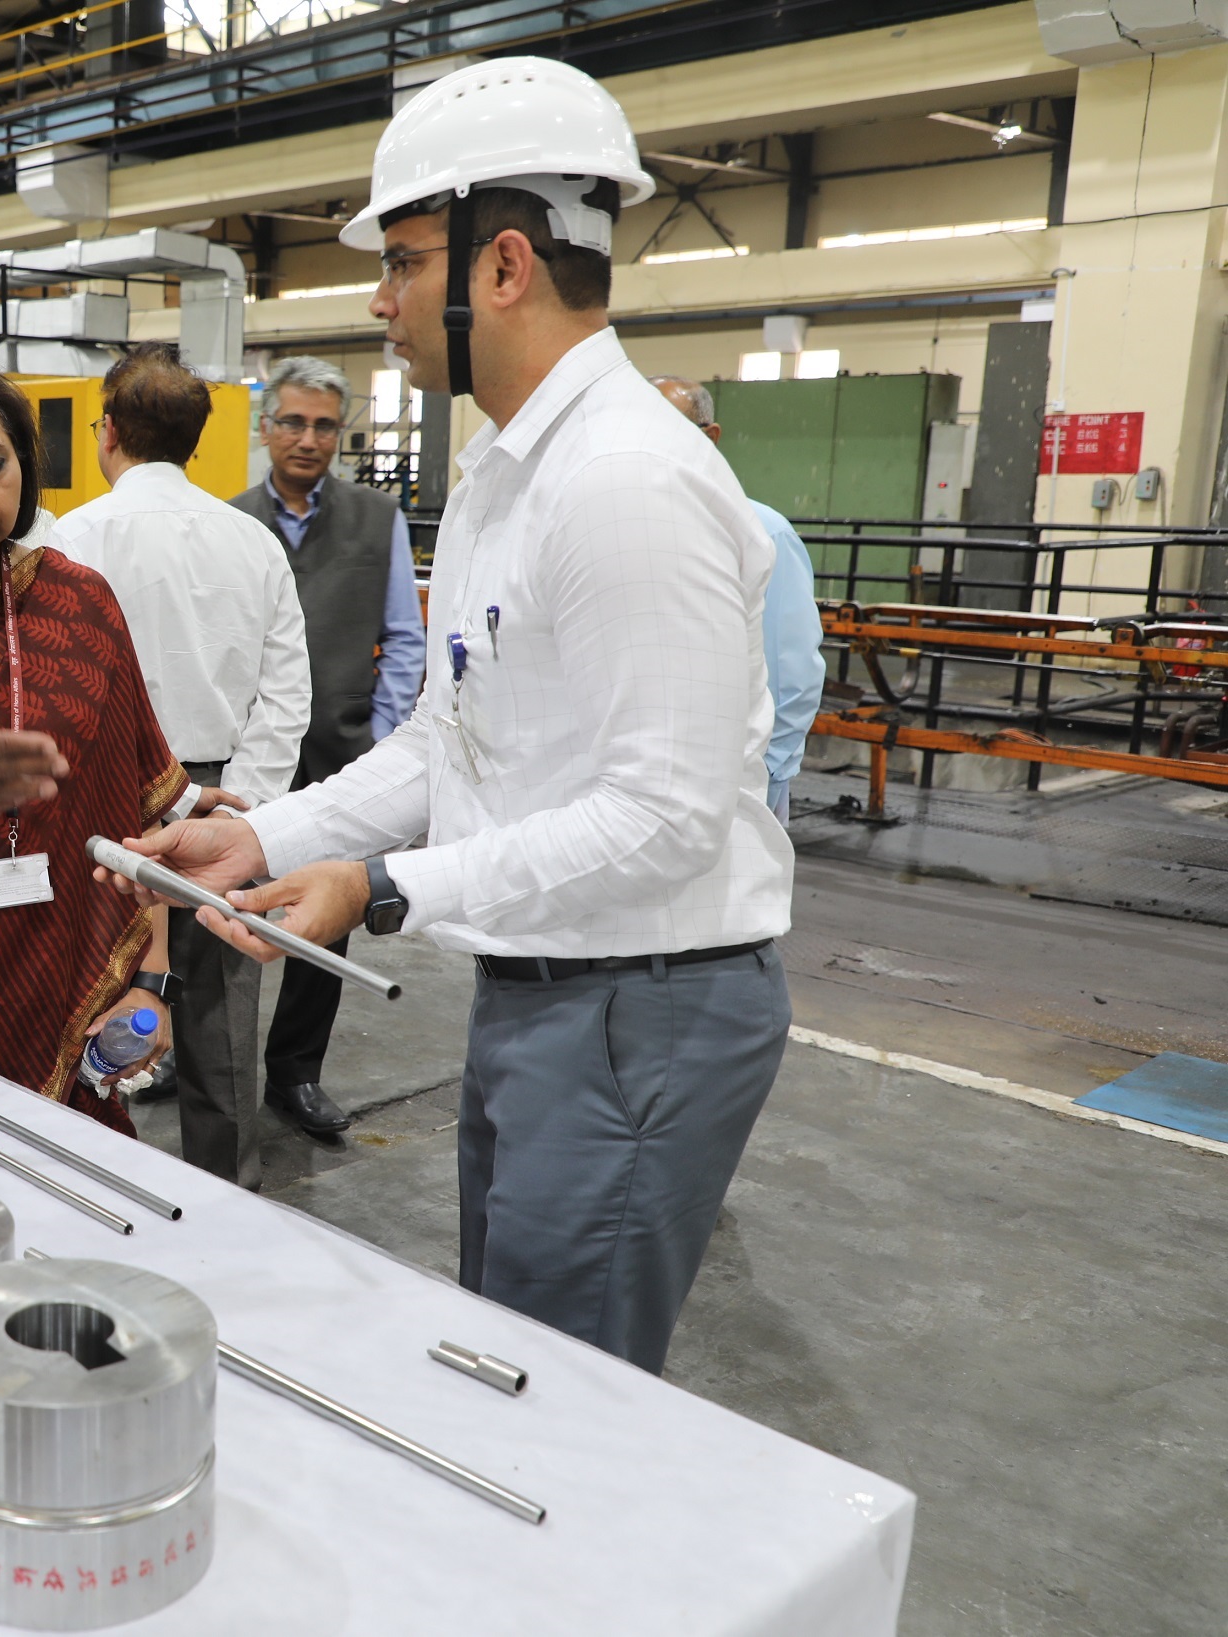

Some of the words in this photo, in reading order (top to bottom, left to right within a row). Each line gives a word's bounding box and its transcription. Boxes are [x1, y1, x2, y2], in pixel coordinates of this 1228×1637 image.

[1078, 415, 1110, 426] POINT
[1120, 414, 1128, 425] 4
[1117, 443, 1126, 453] 4
[91, 1047, 118, 1071] AQUAFINA
